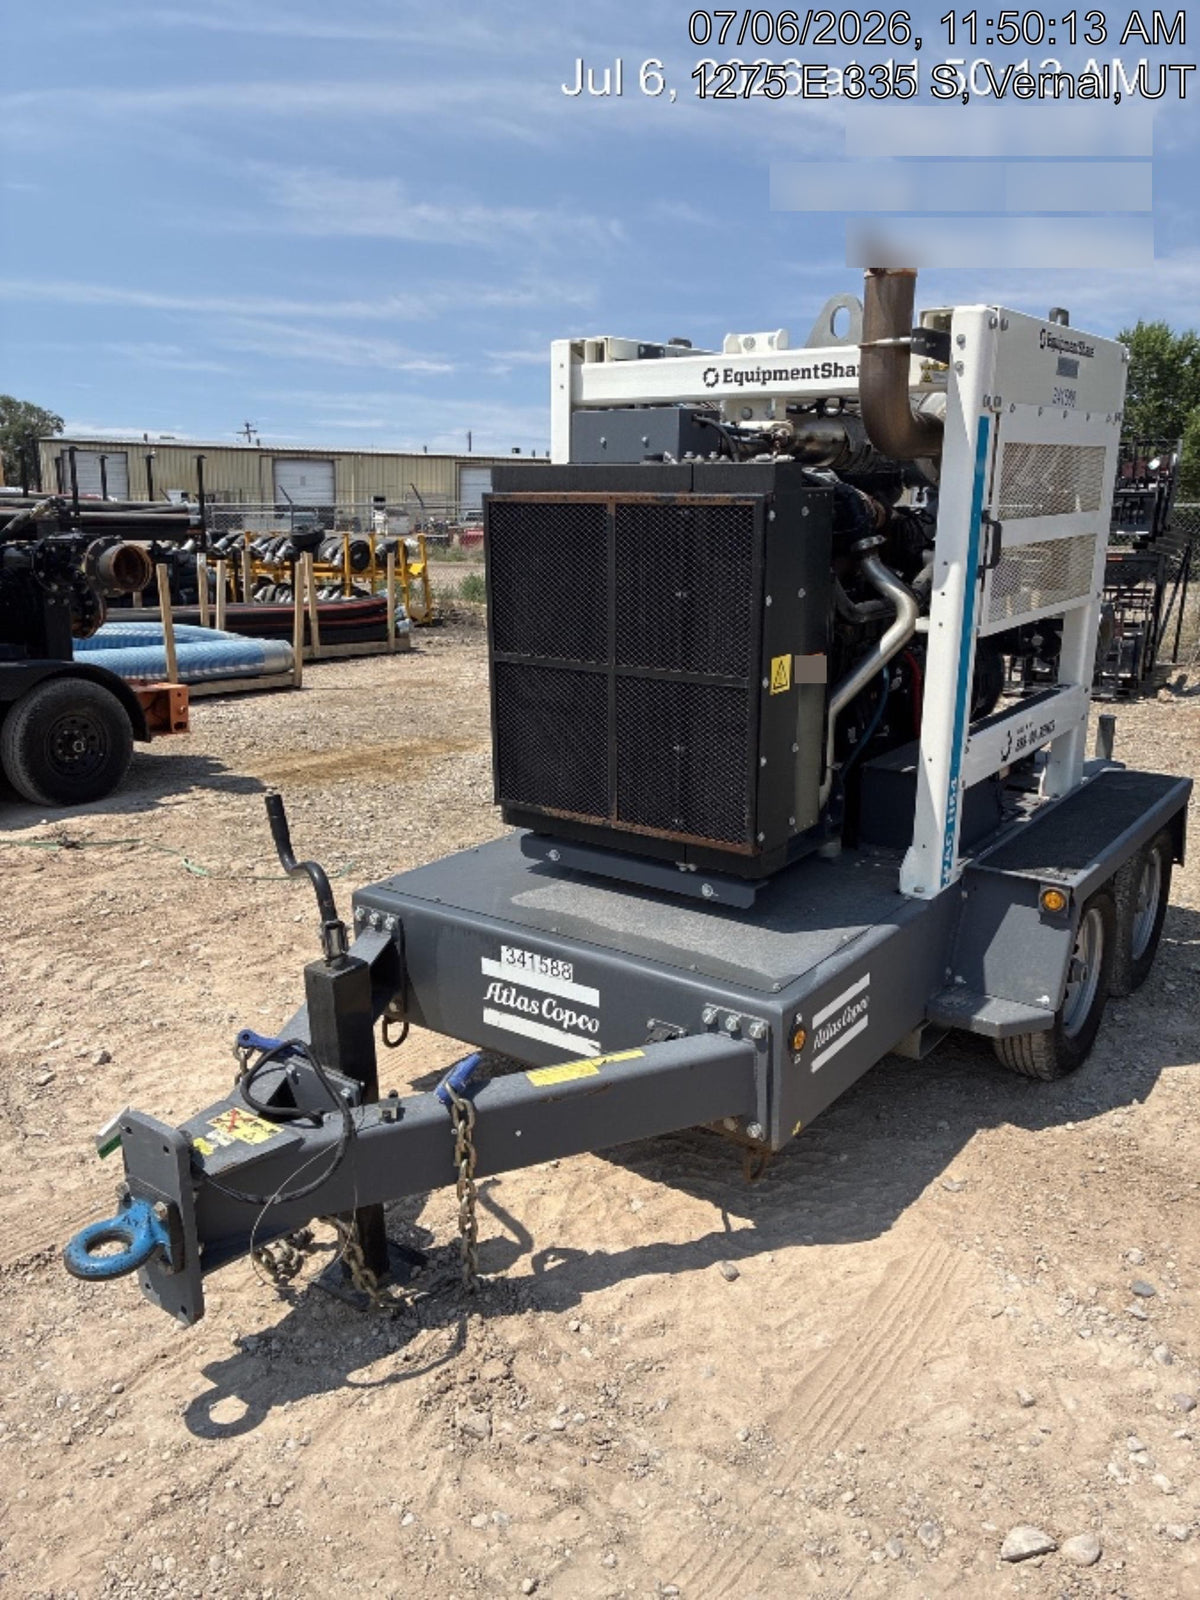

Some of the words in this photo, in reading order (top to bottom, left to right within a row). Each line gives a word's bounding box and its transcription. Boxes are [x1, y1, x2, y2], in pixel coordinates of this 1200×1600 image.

[722, 361, 860, 386] EquipmentSha
[504, 946, 573, 981] 341588
[483, 982, 540, 1015] Atlas
[541, 997, 600, 1034] Copco
